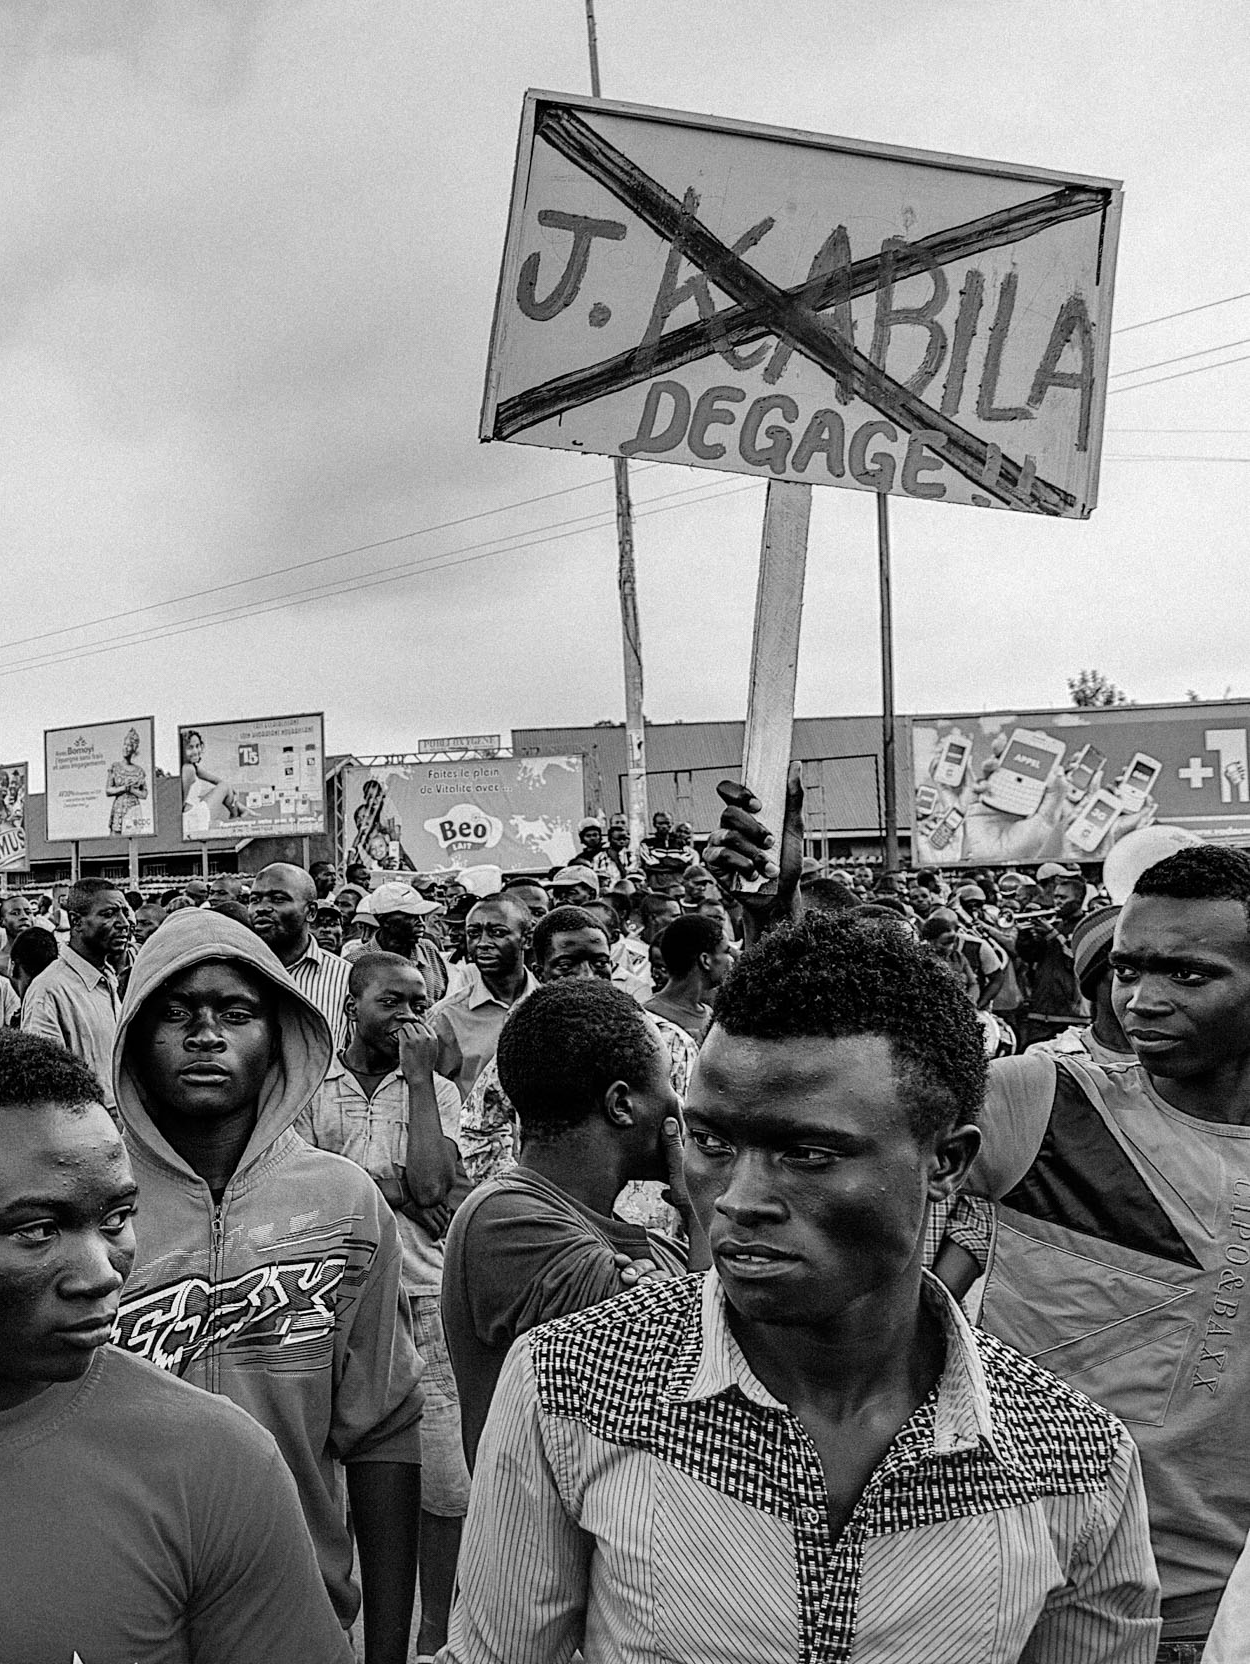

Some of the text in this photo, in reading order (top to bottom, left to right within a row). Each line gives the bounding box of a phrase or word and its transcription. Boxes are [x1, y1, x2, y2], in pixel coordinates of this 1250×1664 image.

[516, 186, 1096, 452] J. KABILA
[1013, 754, 1040, 769] APPEL
[428, 768, 499, 779] Faites le plein
[420, 785, 432, 794] de
[439, 820, 487, 841] Beo
[453, 843, 472, 851] LAIT
